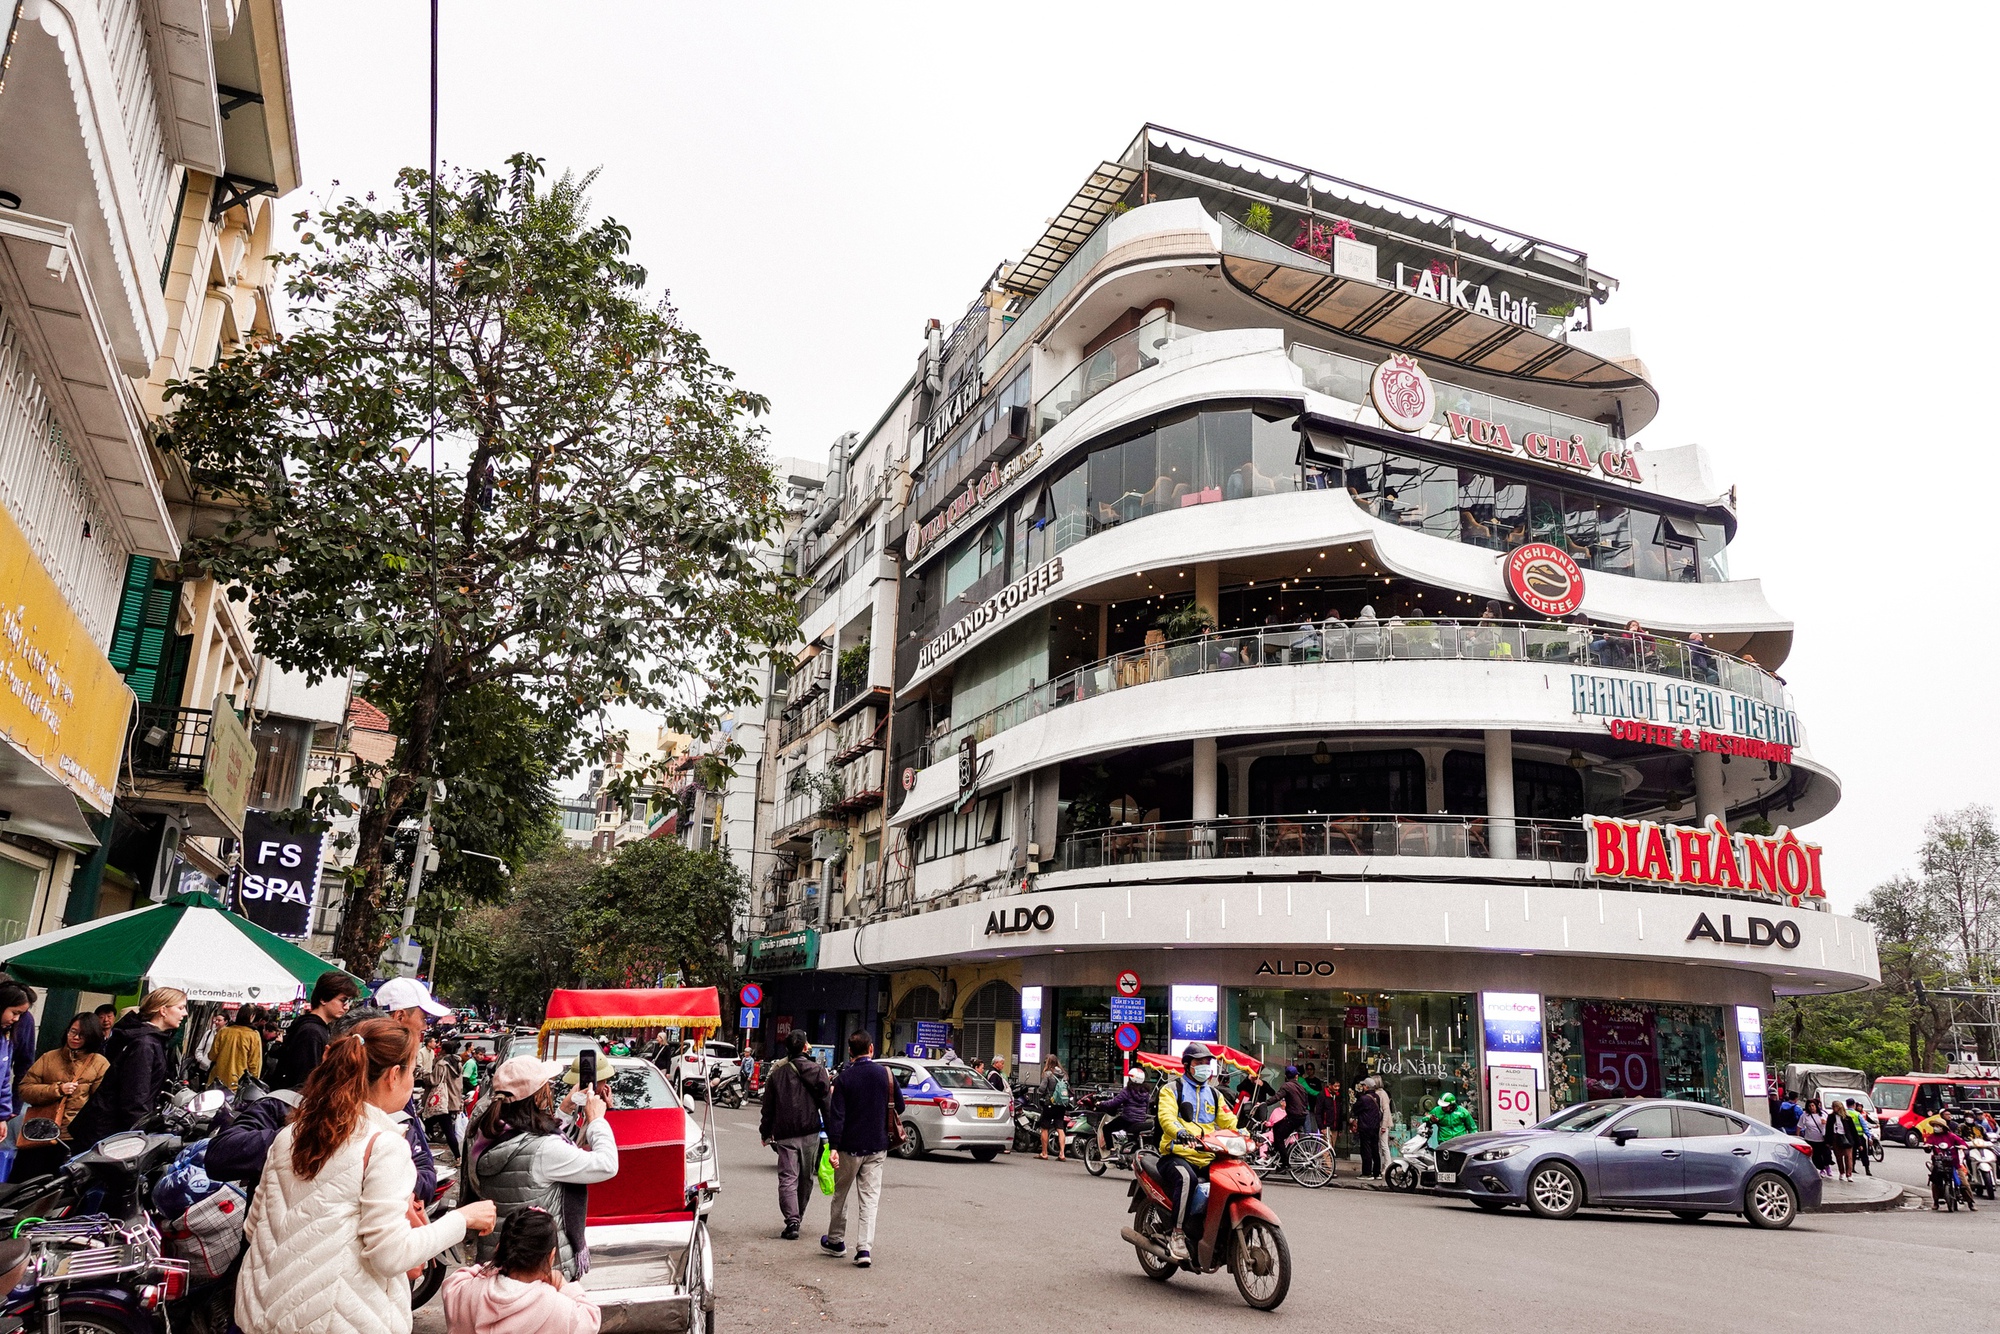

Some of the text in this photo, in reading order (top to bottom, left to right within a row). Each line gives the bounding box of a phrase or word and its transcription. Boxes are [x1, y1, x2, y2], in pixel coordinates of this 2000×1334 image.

[1396, 262, 1538, 328] LAIKA Café
[927, 373, 982, 452] LAIKA Café
[1444, 410, 1644, 483] VUA CHẢ CÁ
[921, 511, 948, 545] VUA
[947, 479, 978, 524] CHẢ
[977, 461, 1002, 499] CÁ
[1513, 547, 1580, 583] HIGHLANDS
[919, 558, 1062, 669] HIGHLANDS COFFEE
[1522, 590, 1574, 613] COFFEE
[1571, 674, 1801, 748] HANOI 1930 BISTRO
[1610, 719, 1793, 764] COFFEE & RESTAURANT
[258, 841, 302, 867] FS
[1592, 819, 1827, 908] BIA HÀ NỘI
[242, 874, 307, 903] SPA
[985, 905, 1055, 936] ALDO
[1686, 912, 1801, 949] ALDO
[1255, 960, 1335, 977] ALDO
[182, 988, 243, 999] Vietcombank
[1176, 994, 1214, 1003] mobifone
[1489, 1003, 1536, 1012] mobifone
[1185, 1023, 1203, 1032] RLH
[1502, 1034, 1525, 1044] RLH
[1406, 1054, 1448, 1080] Nắng
[1599, 1053, 1648, 1091] 50
[1498, 1090, 1530, 1112] 50
